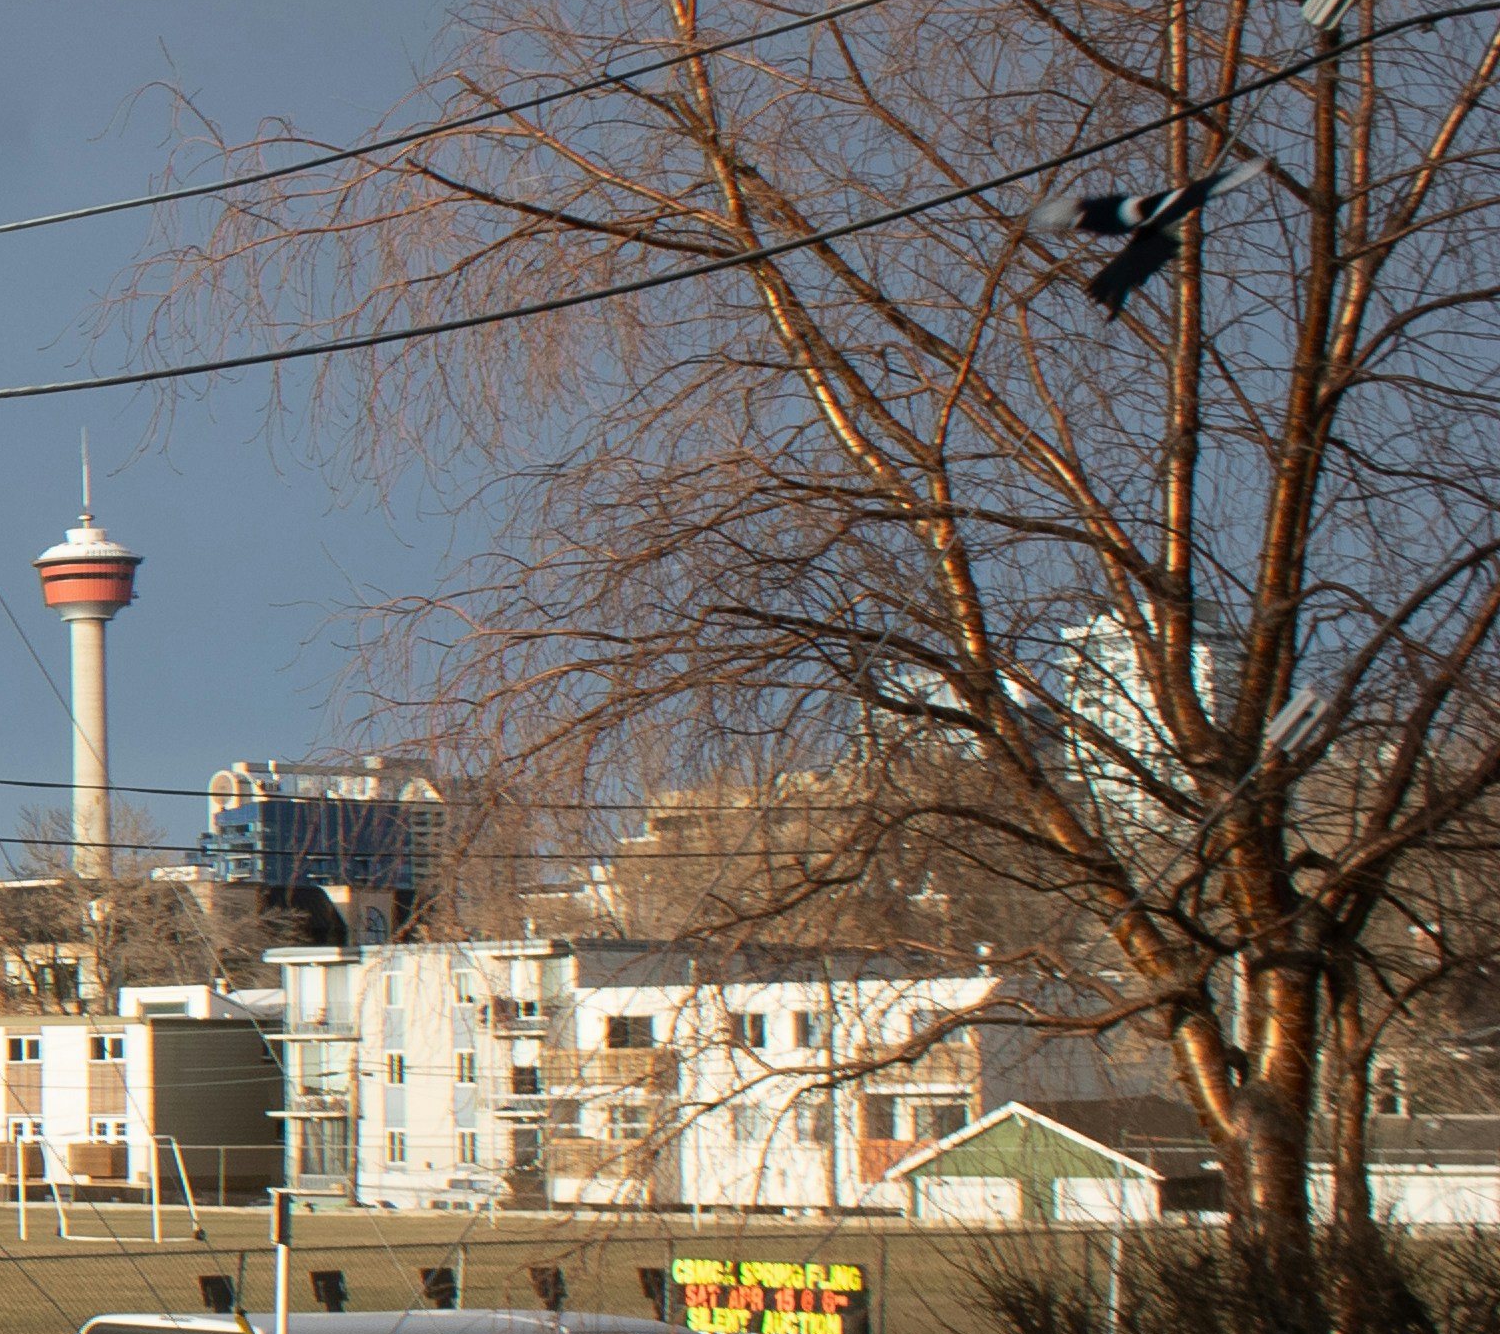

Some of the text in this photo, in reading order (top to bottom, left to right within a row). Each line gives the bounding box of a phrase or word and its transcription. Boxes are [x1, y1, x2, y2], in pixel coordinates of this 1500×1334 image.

[739, 1261, 805, 1289] SPRING
[805, 1263, 862, 1291] FLING
[685, 1284, 721, 1308] SAT
[728, 1285, 764, 1312] APR
[774, 1288, 795, 1312] 15
[687, 1306, 752, 1334] SILENT
